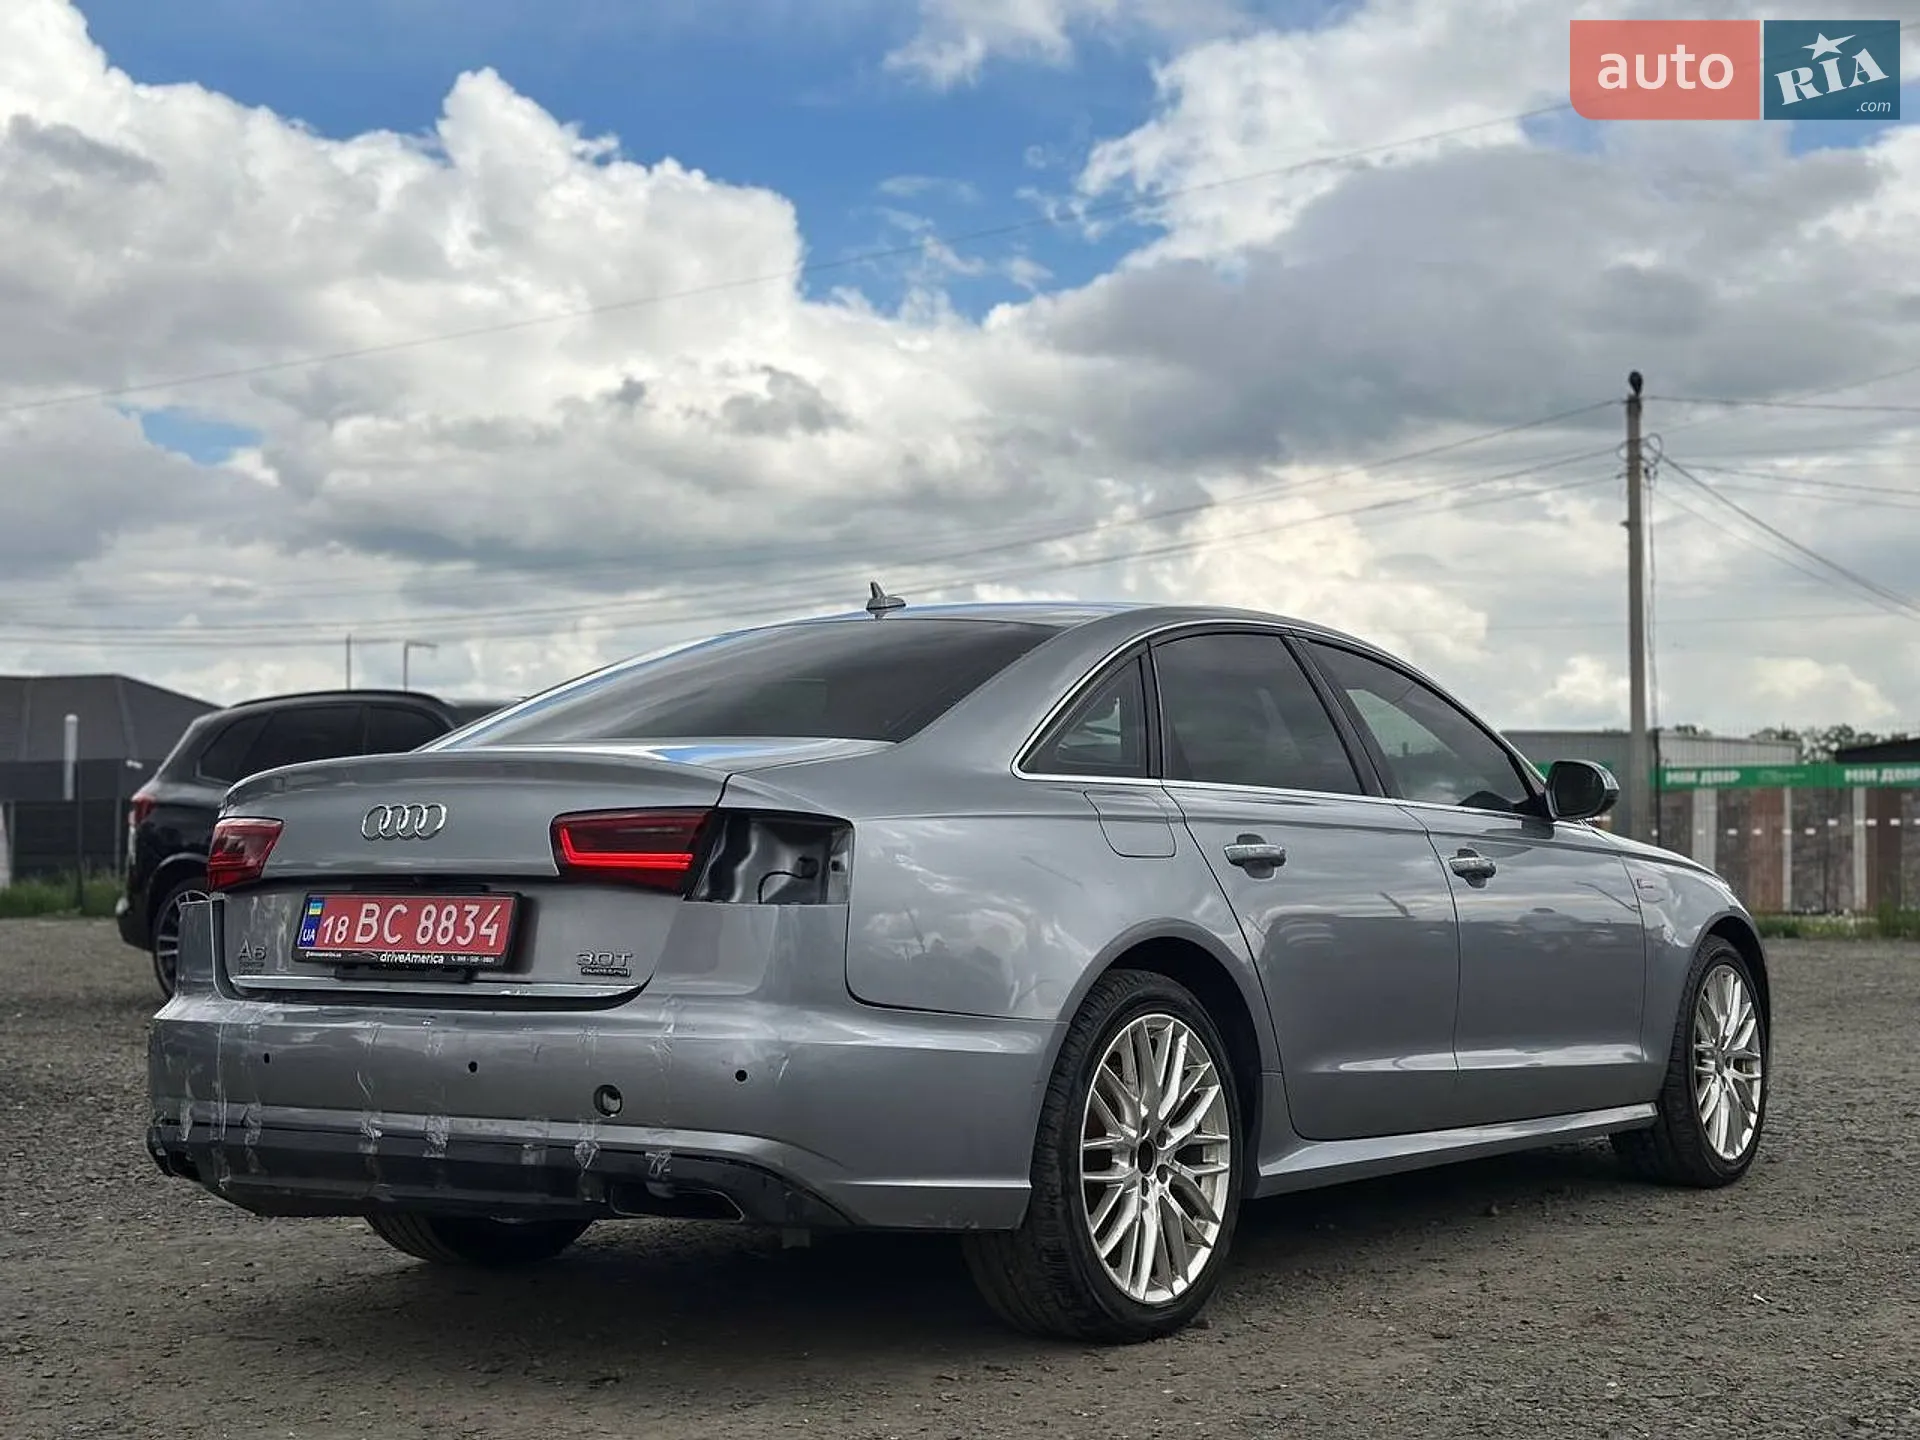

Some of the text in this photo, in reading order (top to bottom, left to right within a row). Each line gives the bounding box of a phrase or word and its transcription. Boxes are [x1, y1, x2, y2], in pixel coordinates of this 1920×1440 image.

[322, 903, 501, 947] 18 BC 8834
[301, 928, 316, 942] UA
[379, 952, 444, 965] driveAmerica
